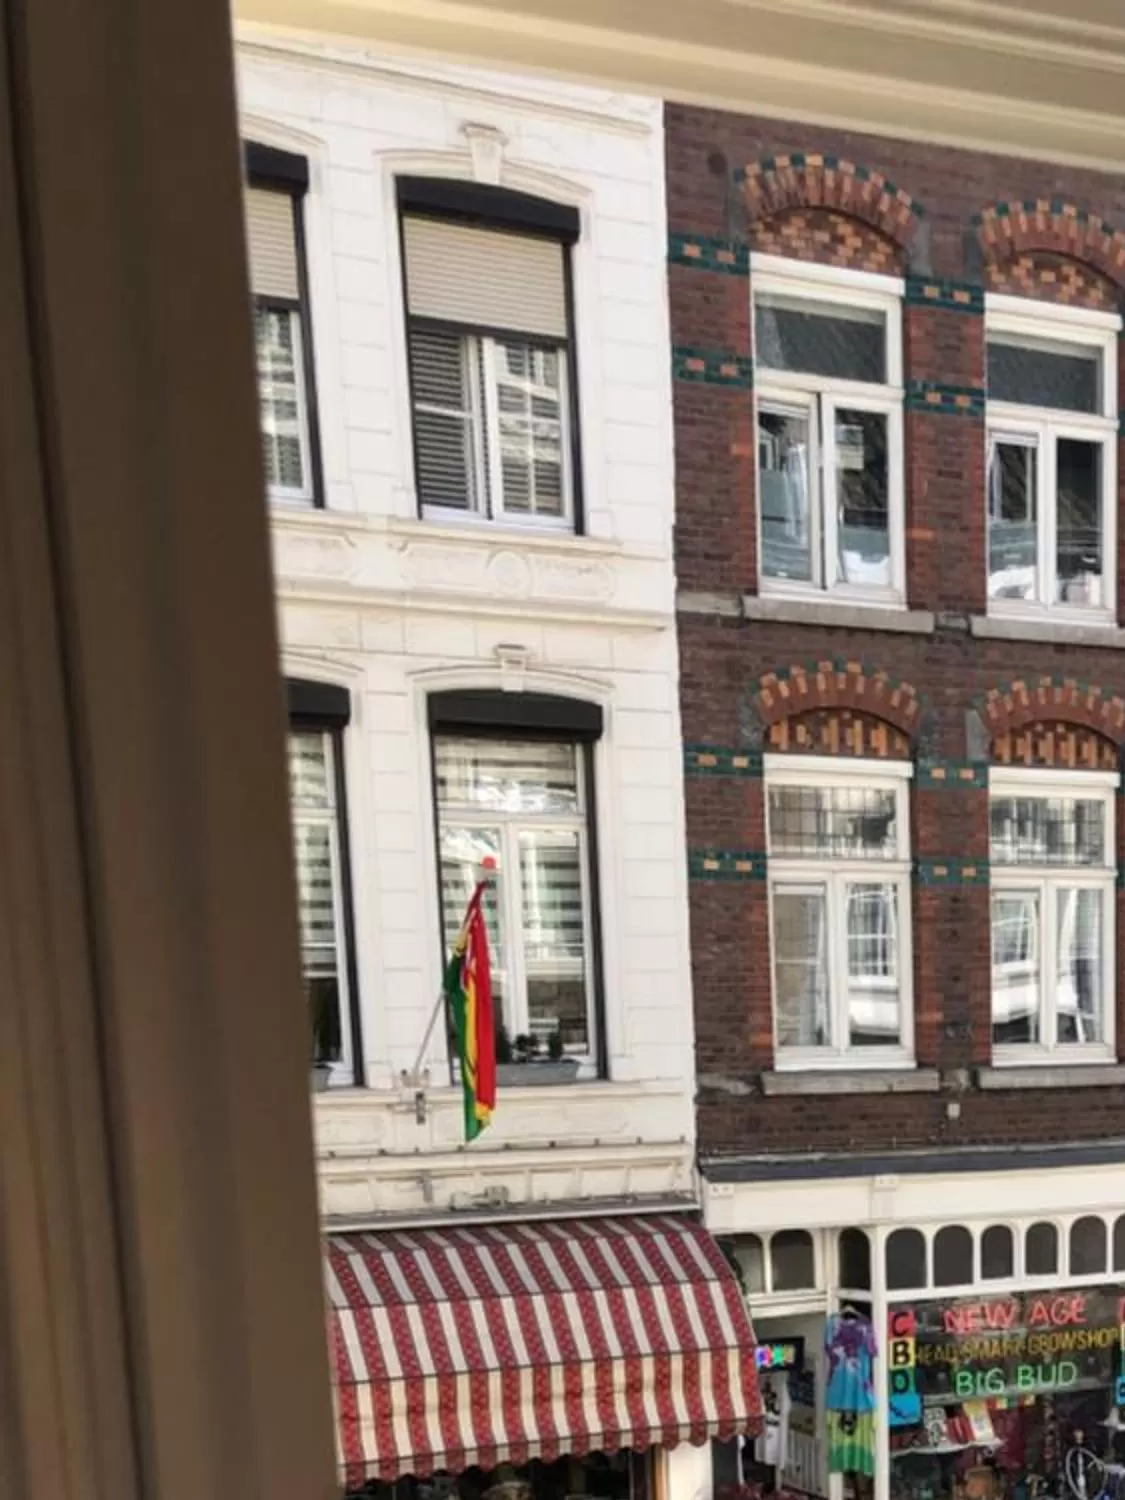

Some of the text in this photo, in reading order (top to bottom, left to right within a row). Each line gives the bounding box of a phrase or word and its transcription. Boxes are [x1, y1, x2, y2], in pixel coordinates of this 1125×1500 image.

[944, 1293, 1087, 1334] NEW AGE
[955, 1361, 1077, 1397] BIG BUD
